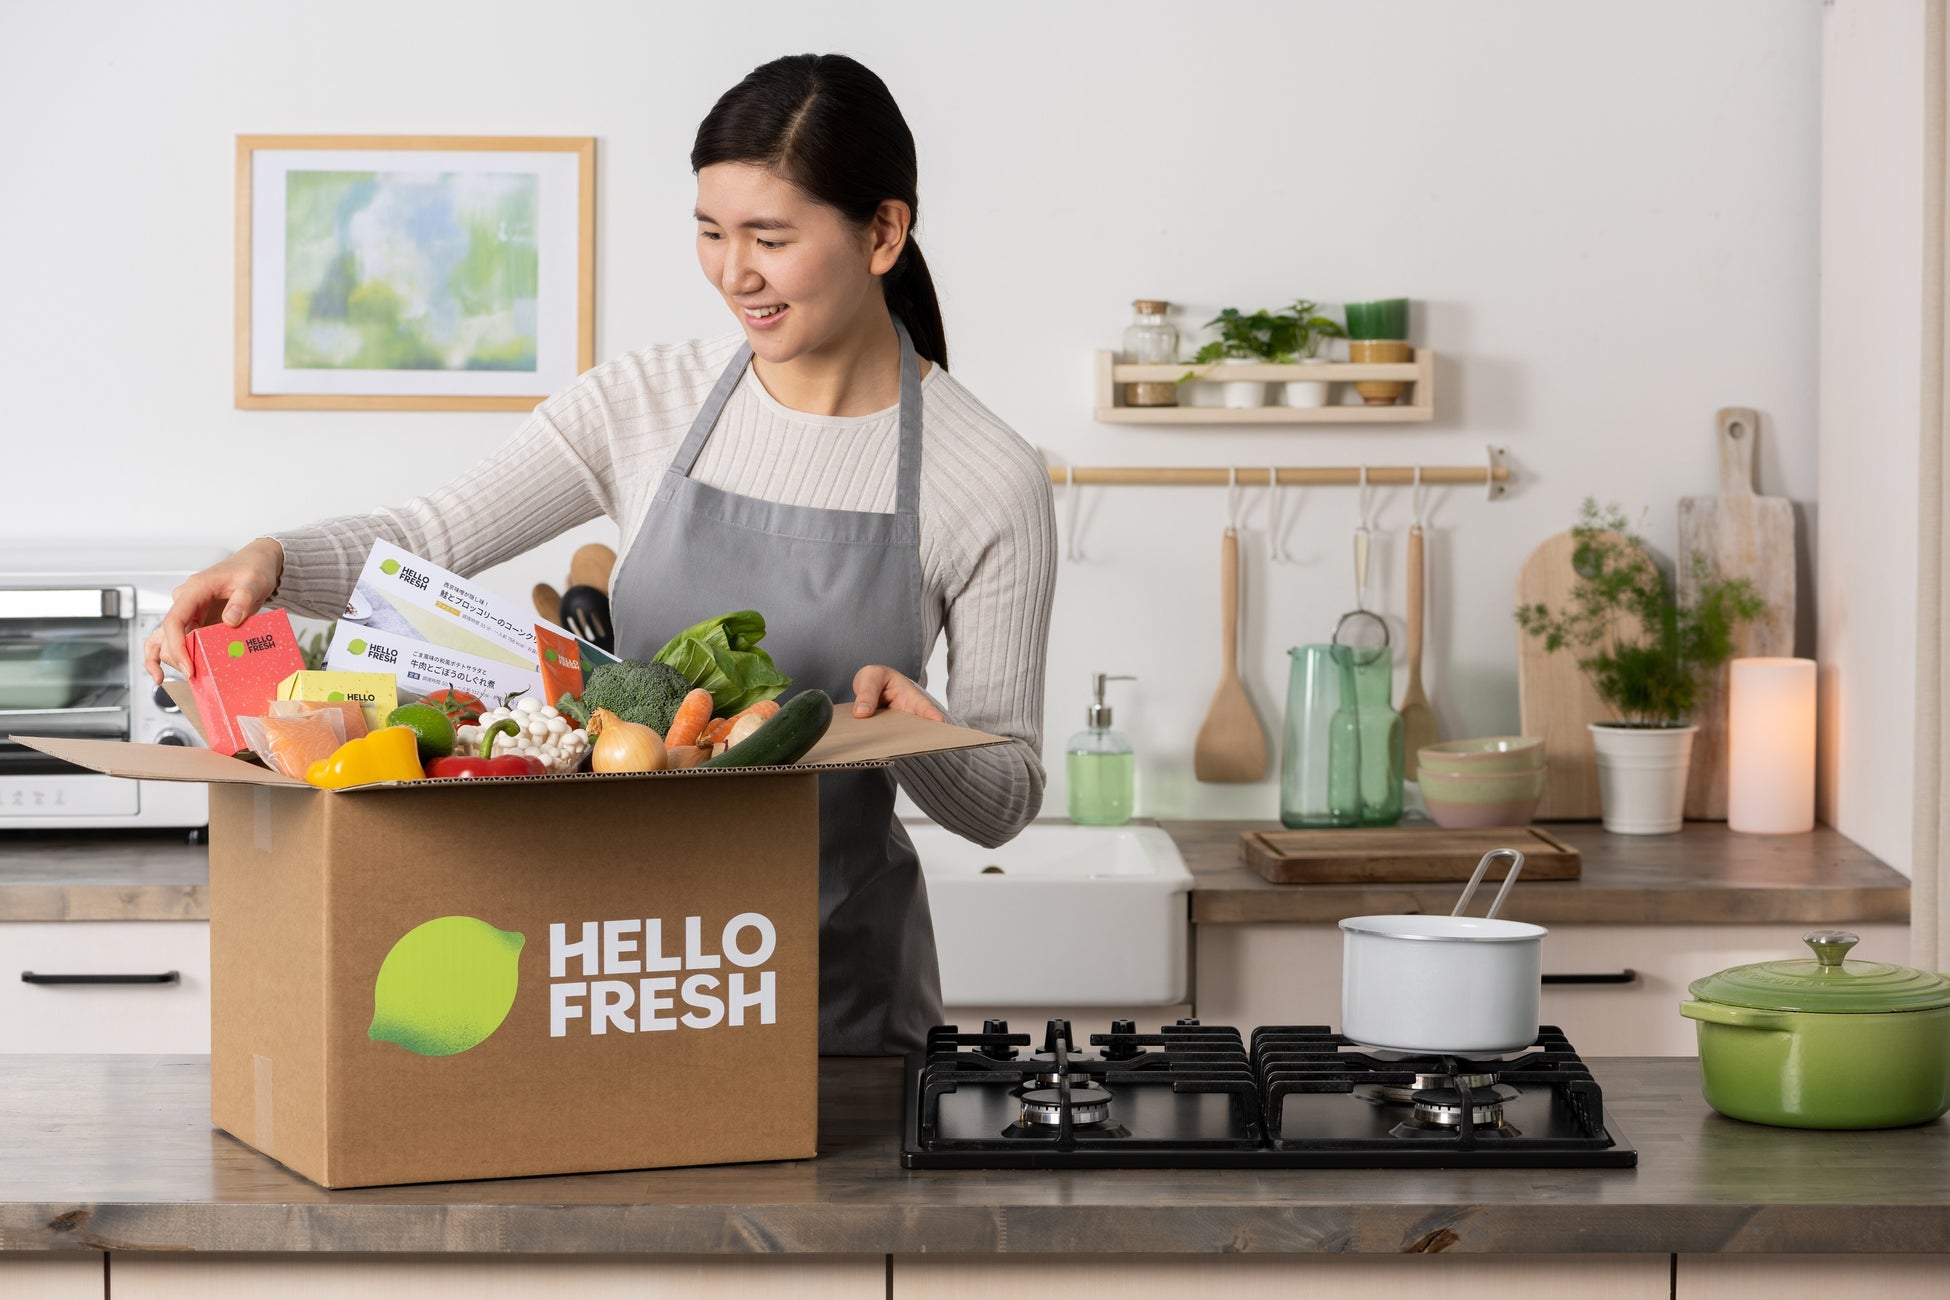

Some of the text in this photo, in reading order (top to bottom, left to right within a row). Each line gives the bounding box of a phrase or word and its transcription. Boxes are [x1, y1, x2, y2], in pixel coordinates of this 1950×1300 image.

[399, 573, 428, 591] FRESH
[402, 566, 430, 584] HELLO
[245, 634, 273, 646] HELLO
[248, 641, 276, 654] FRESH
[367, 650, 397, 664] FRESH
[369, 643, 398, 657] HELLO
[410, 659, 496, 689] 牛肉とごぼうのしぐれ煮
[347, 693, 375, 702] HELLO
[549, 912, 777, 978] HELLO
[549, 970, 776, 1038] FRESH
